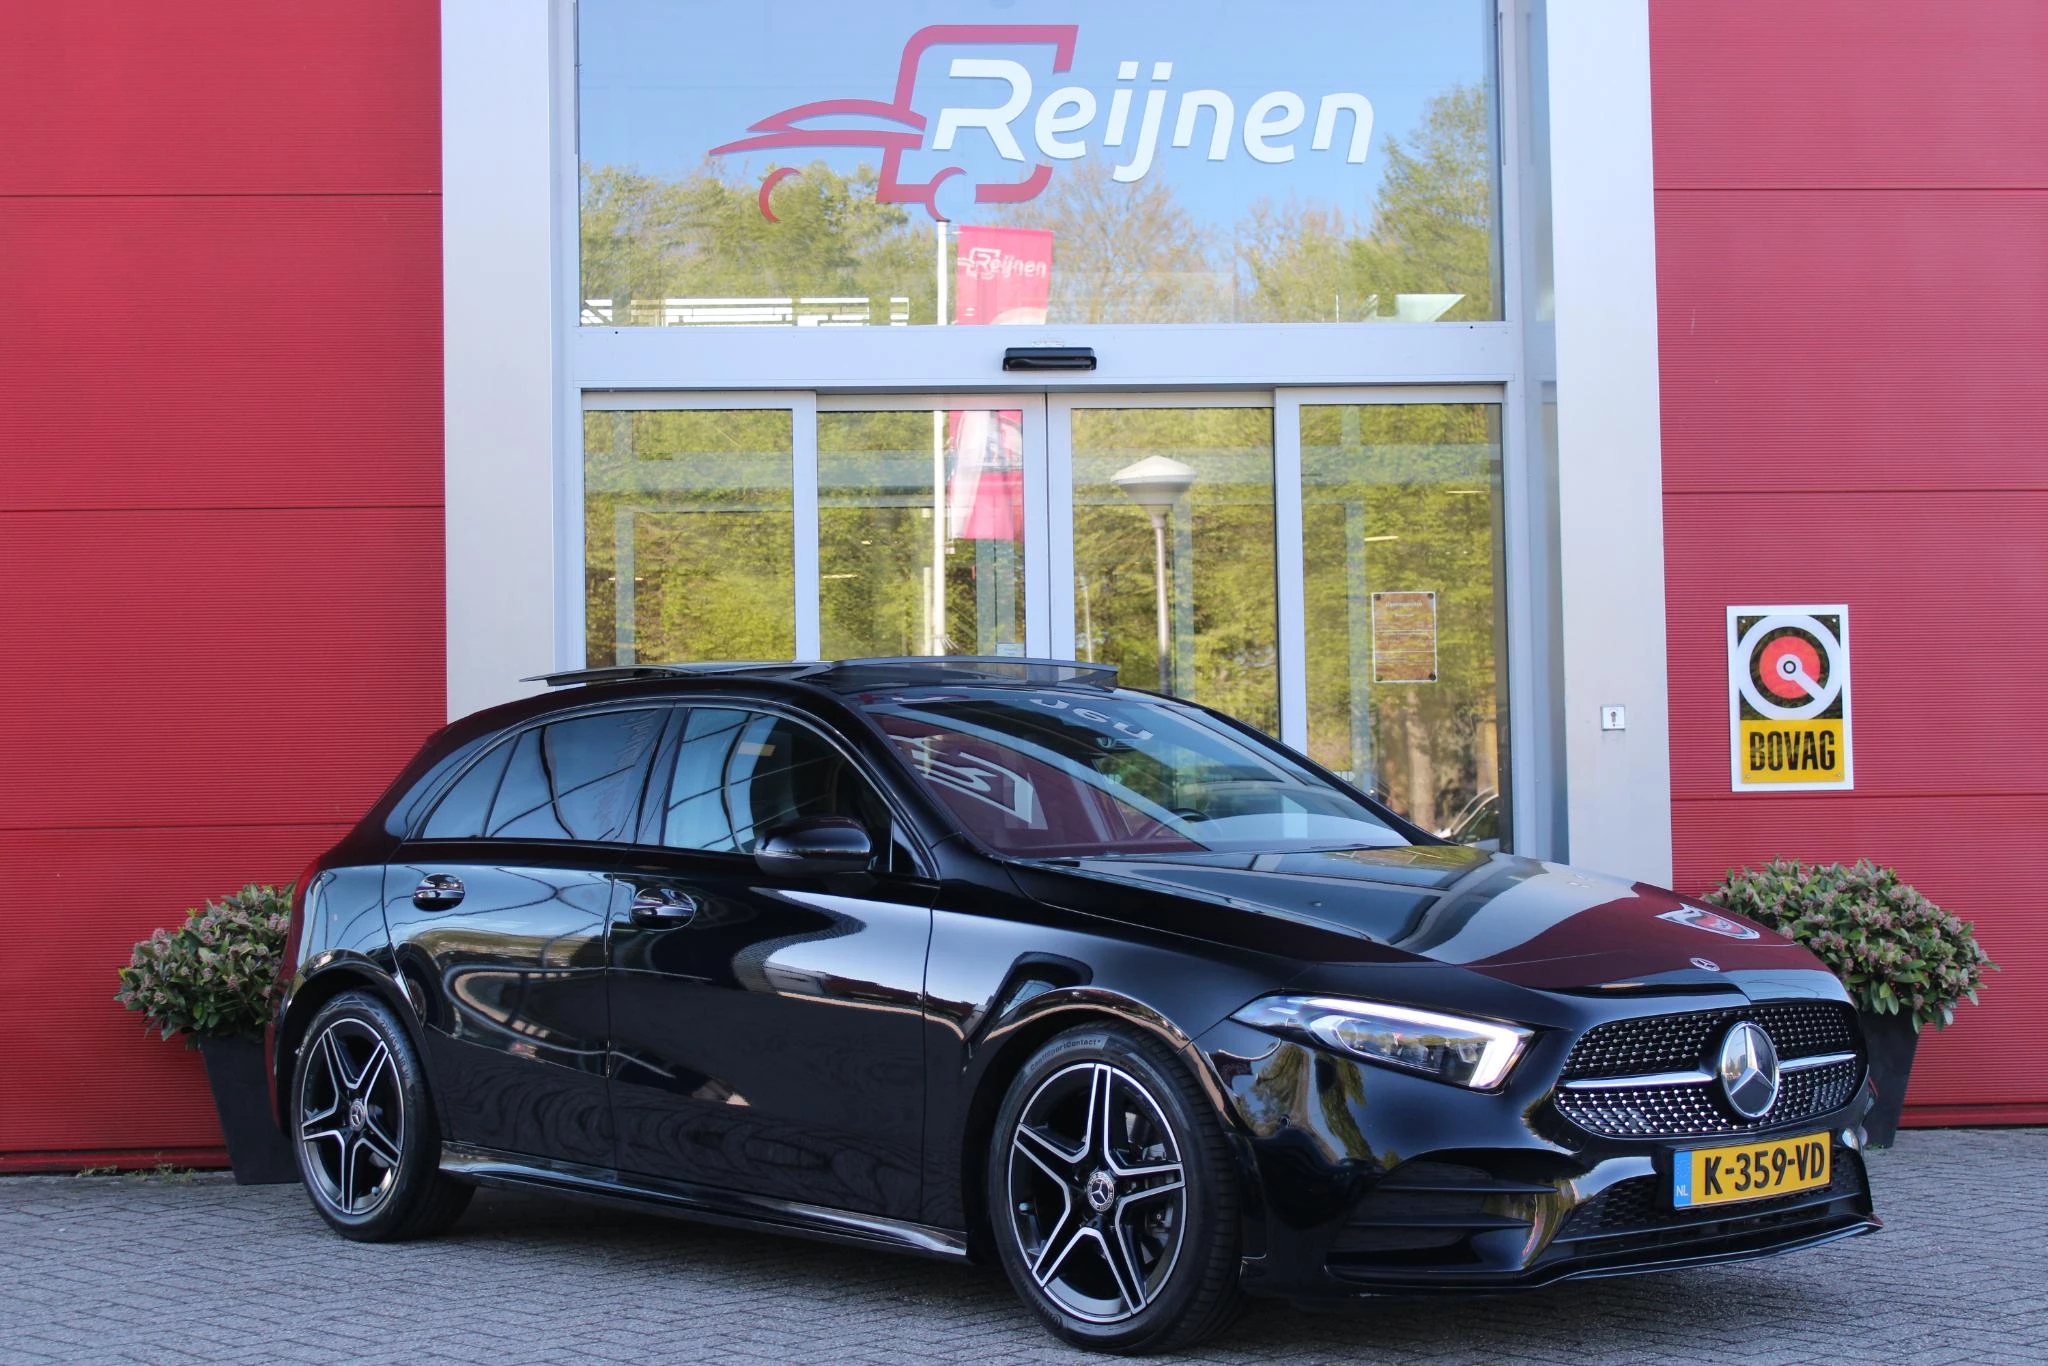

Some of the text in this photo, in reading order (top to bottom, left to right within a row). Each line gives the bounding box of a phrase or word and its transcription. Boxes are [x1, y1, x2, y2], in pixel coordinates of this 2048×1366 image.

[932, 58, 1374, 183] Reijnen
[976, 253, 1047, 279] Reijnen
[1750, 730, 1835, 771] BOVAG
[1704, 1142, 1825, 1196] K-359-VD
[1676, 1184, 1689, 1197] NL
